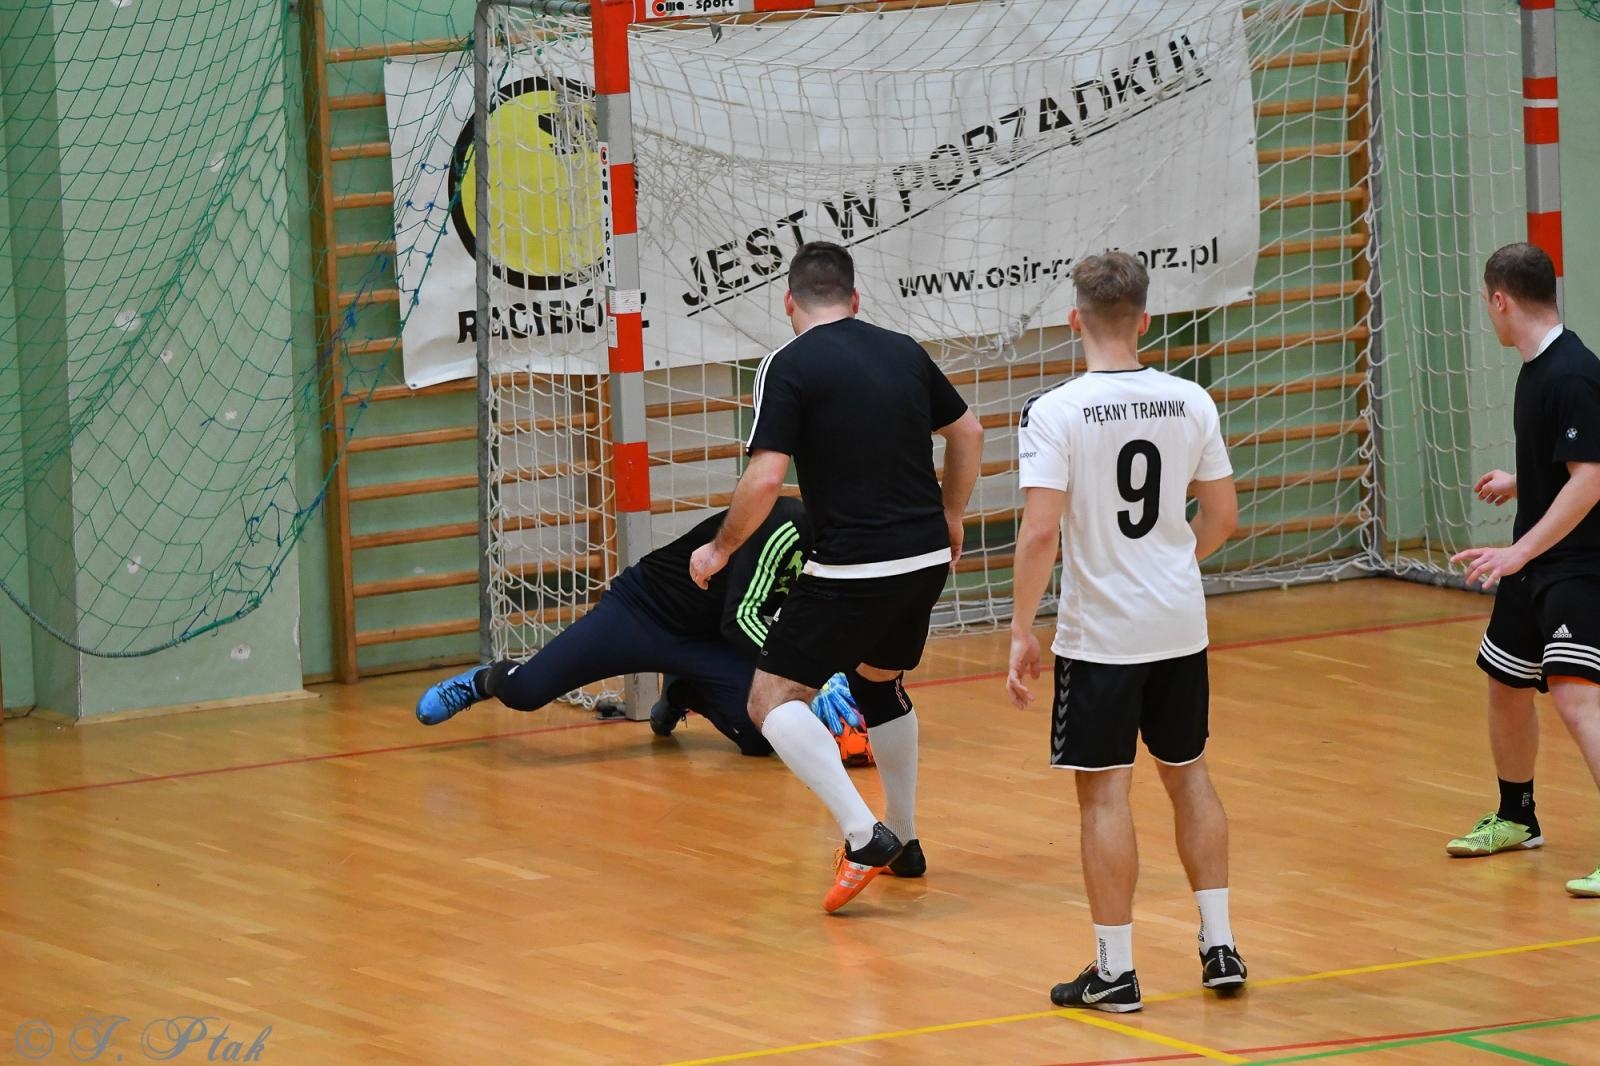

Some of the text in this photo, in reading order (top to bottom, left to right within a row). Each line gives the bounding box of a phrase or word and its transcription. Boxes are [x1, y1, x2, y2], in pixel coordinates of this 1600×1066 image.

[696, 0, 734, 12] sport
[682, 209, 808, 306] JEST
[822, 182, 879, 239] W
[1083, 400, 1186, 426] PIĘKNY TRAWNIK
[1117, 439, 1161, 539] 9
